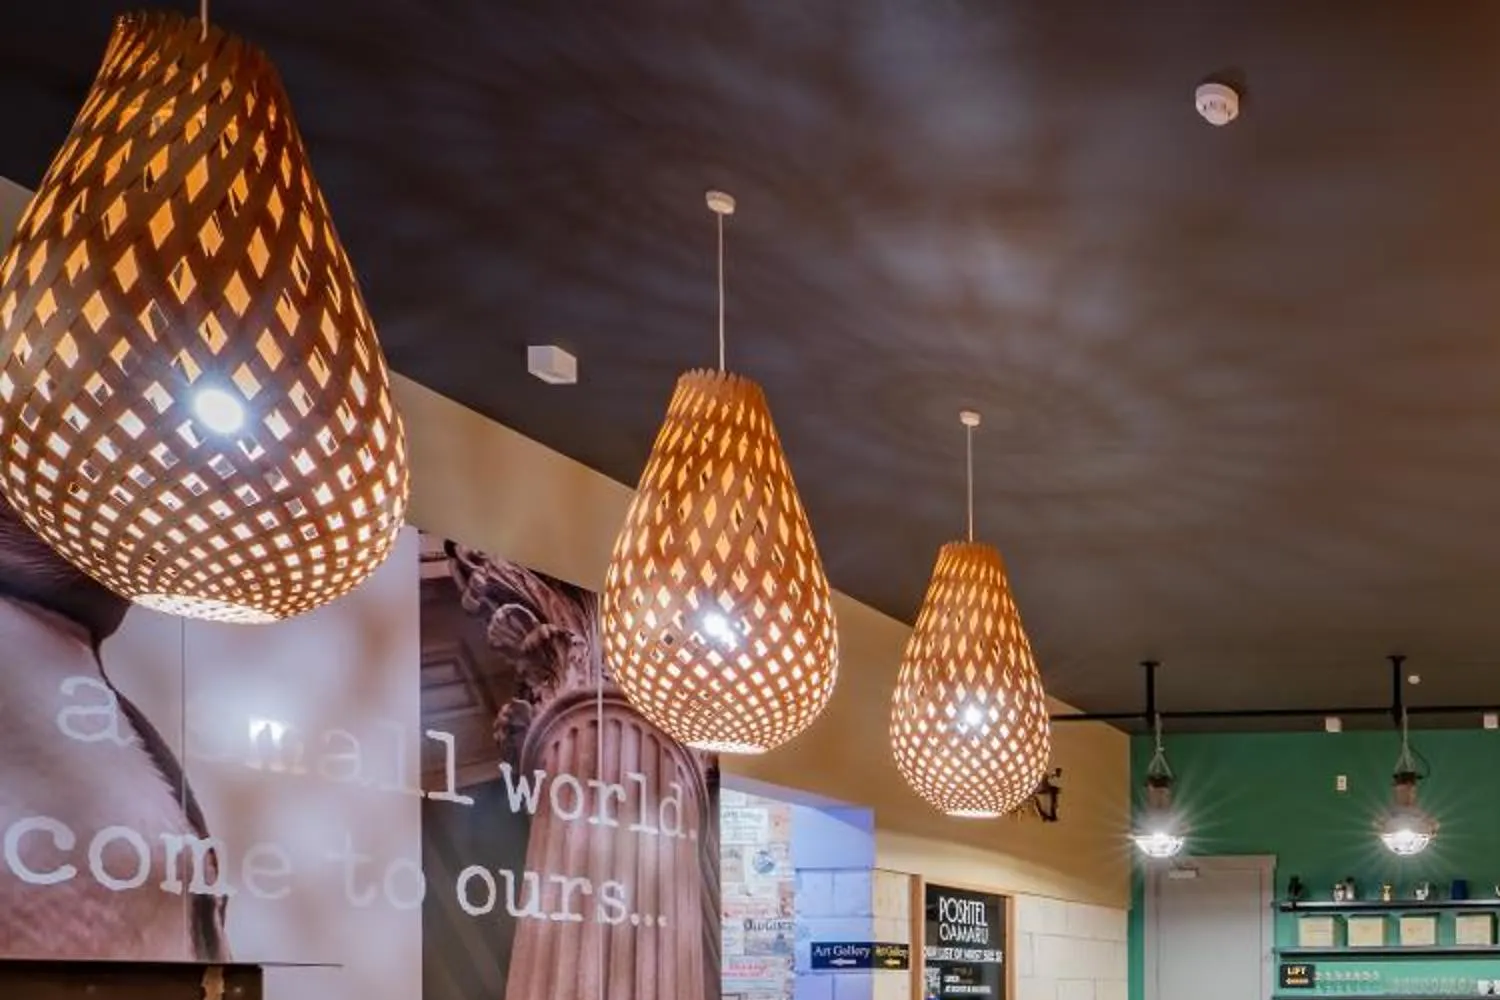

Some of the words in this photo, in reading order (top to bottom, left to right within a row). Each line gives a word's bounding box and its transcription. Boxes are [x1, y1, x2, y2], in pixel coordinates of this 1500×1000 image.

[56, 675, 140, 747] a
[499, 761, 698, 841] world.
[3, 815, 293, 899] come
[323, 831, 426, 911] to
[456, 864, 668, 927] ours...
[939, 896, 988, 926] POSHTEL
[939, 922, 989, 945] OAMARU
[814, 945, 832, 957] Art
[833, 945, 871, 959] Gallery
